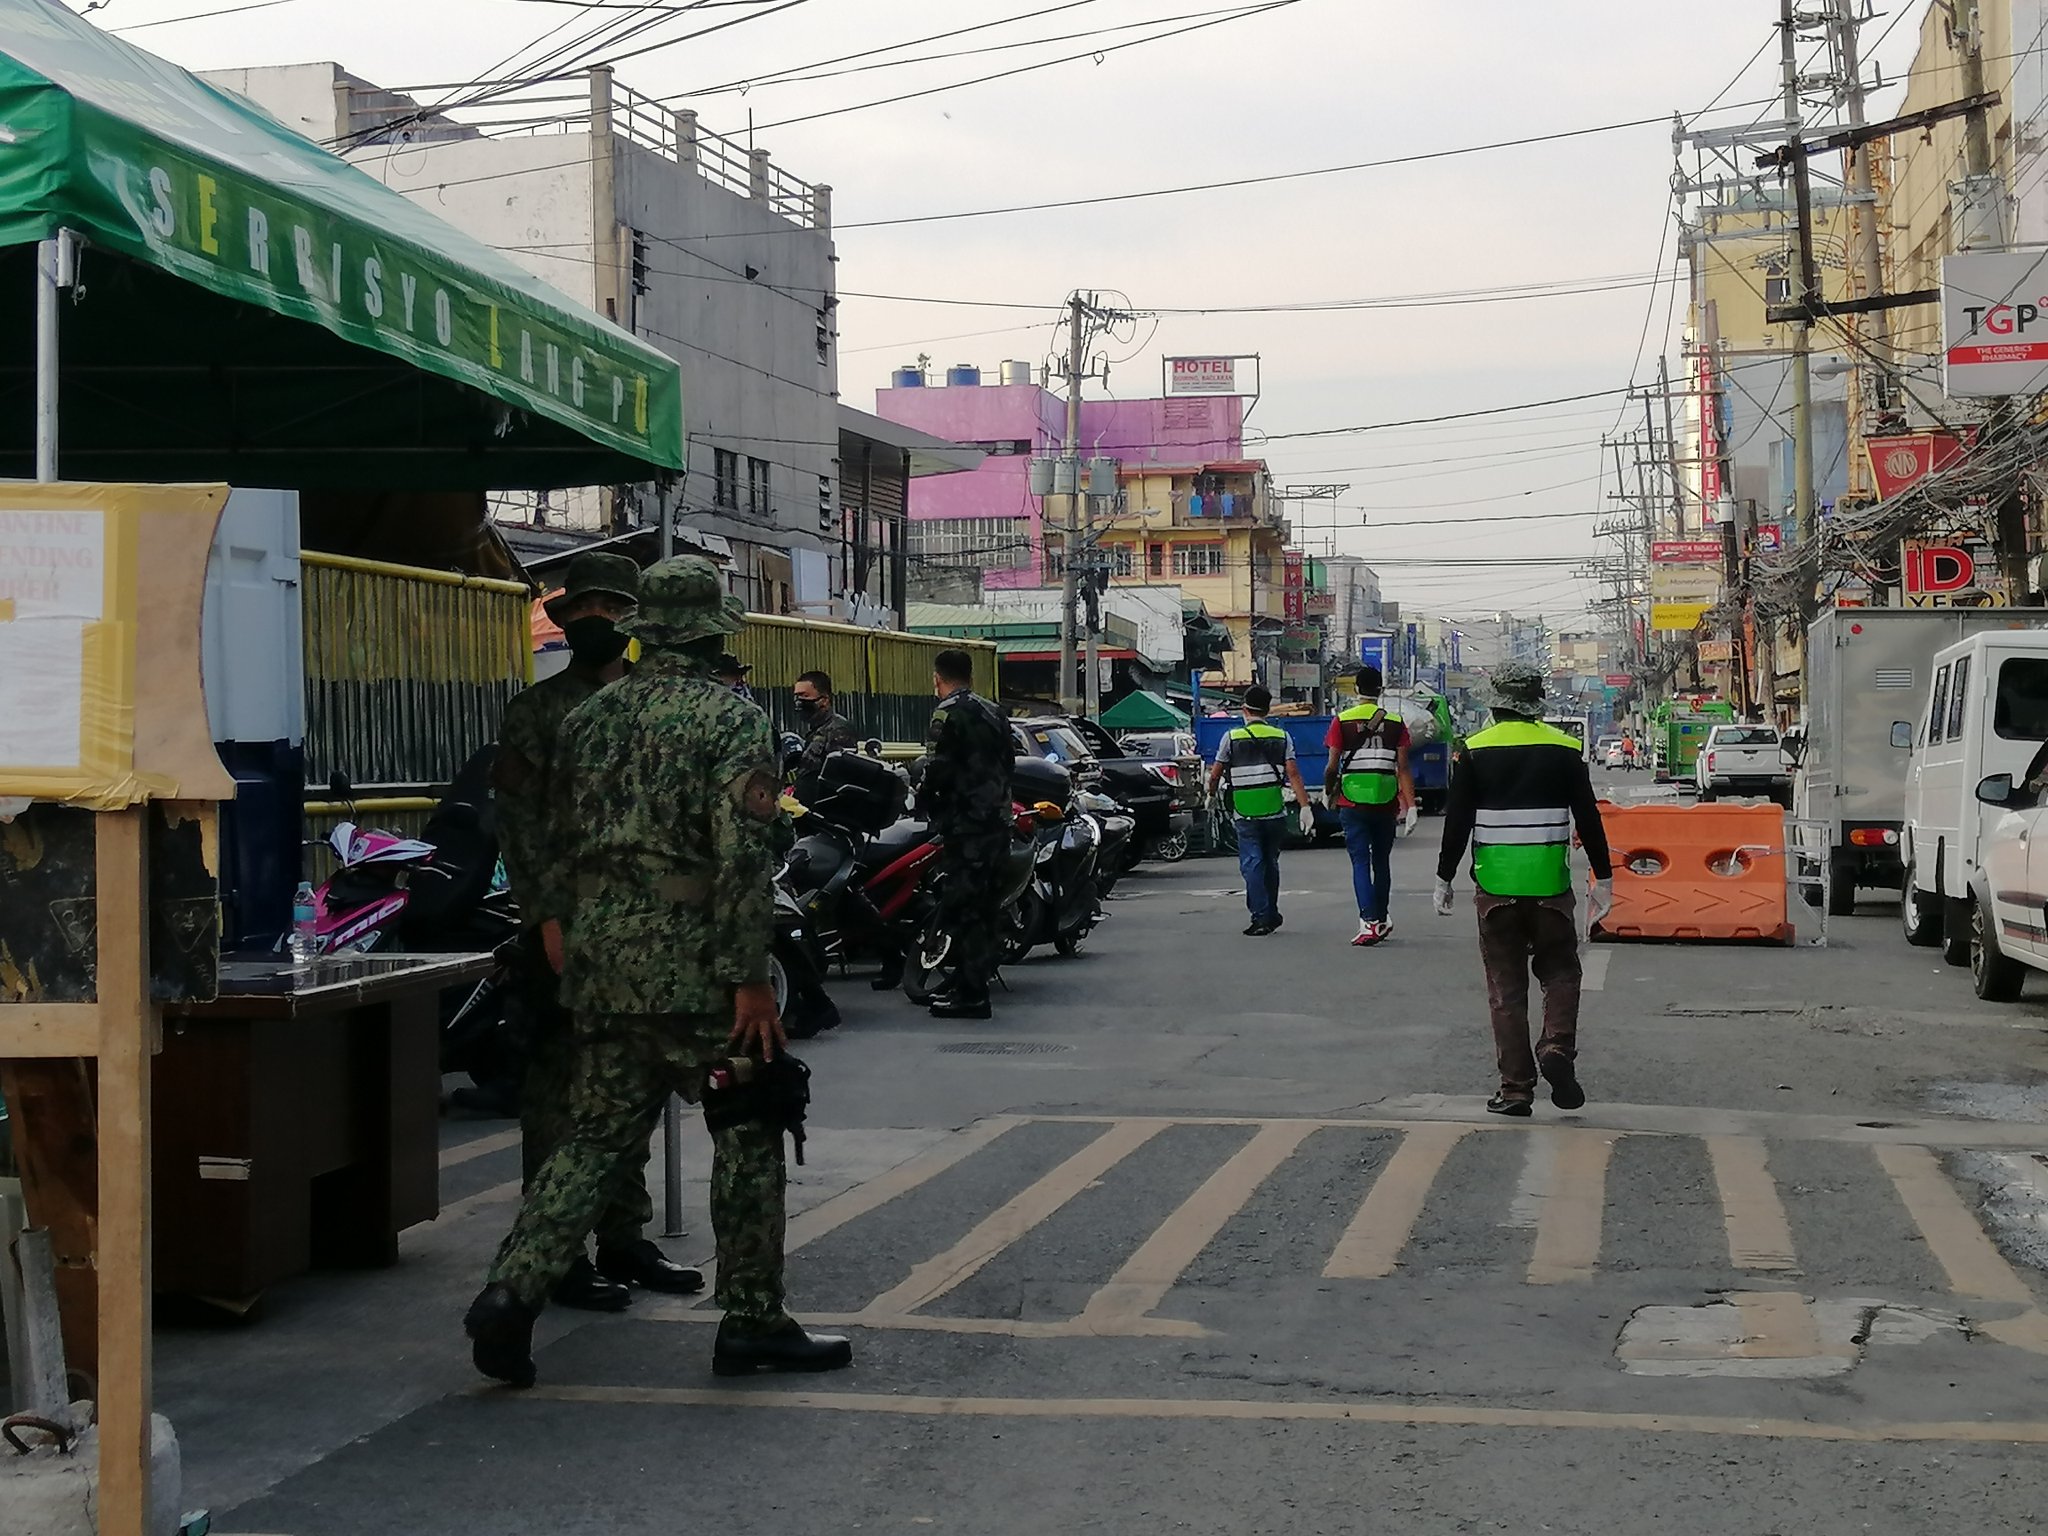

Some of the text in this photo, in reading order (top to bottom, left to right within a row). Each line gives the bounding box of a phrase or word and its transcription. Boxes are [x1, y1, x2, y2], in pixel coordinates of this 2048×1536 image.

[1963, 304, 2038, 335] TGP
[1976, 345, 2033, 355] THE GENERICS
[1981, 353, 2028, 361] PHARMACY
[490, 305, 584, 408] LANG
[613, 374, 648, 434] PO
[1174, 361, 1233, 373] HOTEL
[1905, 547, 1975, 594] ID
